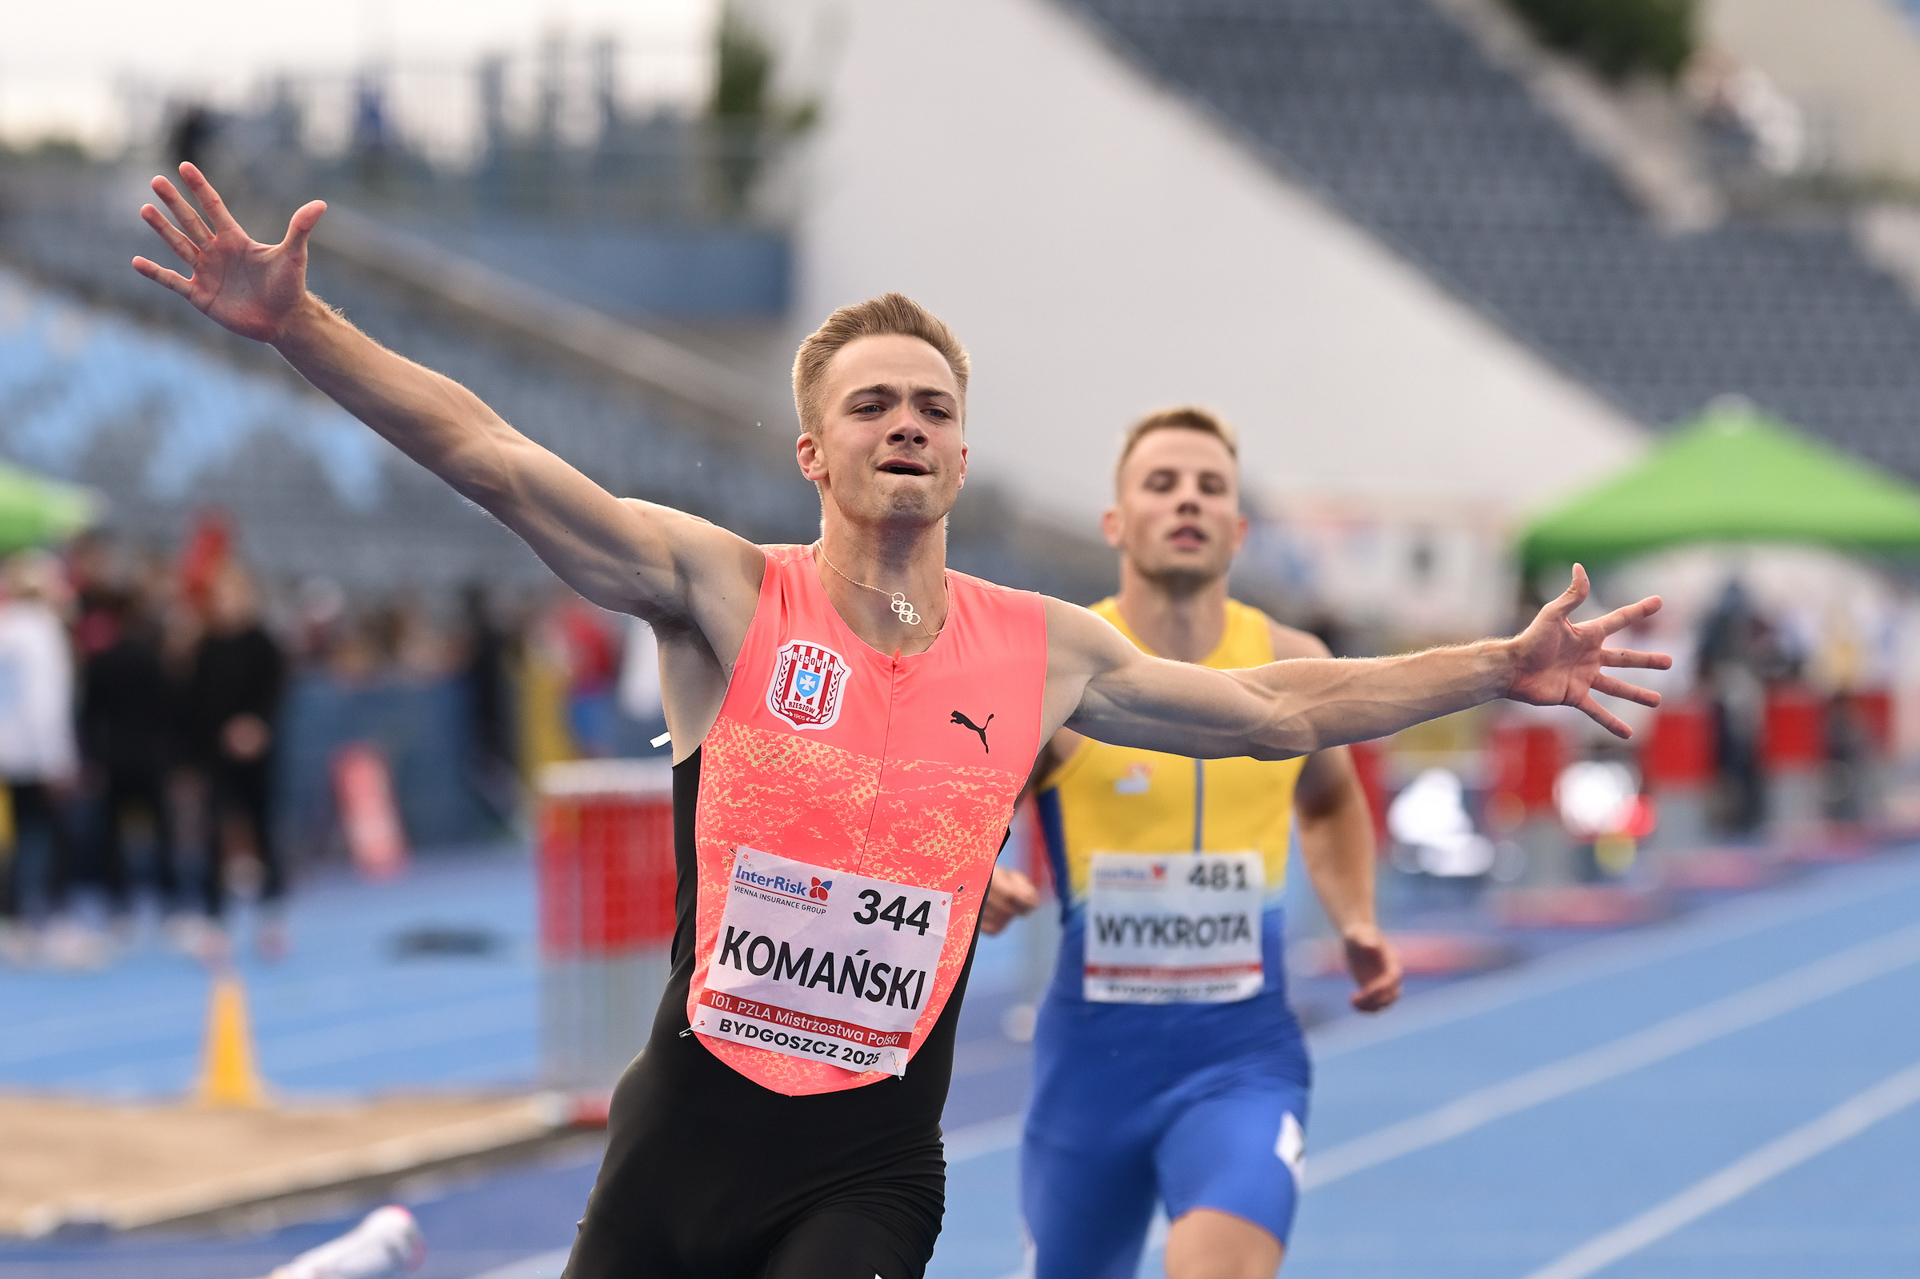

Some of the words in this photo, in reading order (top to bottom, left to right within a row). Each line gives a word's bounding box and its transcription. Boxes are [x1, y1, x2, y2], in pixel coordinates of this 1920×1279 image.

[792, 652, 834, 671] RESOVIA
[735, 864, 808, 897] InterRisk
[1188, 860, 1248, 891] 481
[733, 885, 758, 899] VIENNA
[758, 892, 800, 910] INSURANCE
[801, 904, 827, 916] GROUP
[853, 888, 932, 936] 344
[1095, 914, 1251, 947] WYKROTA
[718, 925, 927, 1011] KOMAŃSKI
[710, 993, 733, 1010] 101.
[737, 1001, 771, 1021] PZLA
[775, 1010, 864, 1043] Mistrzostwa
[867, 1032, 901, 1046] Polski
[718, 1018, 839, 1059] BYDGOSZCZ
[841, 1047, 882, 1066] 2025
